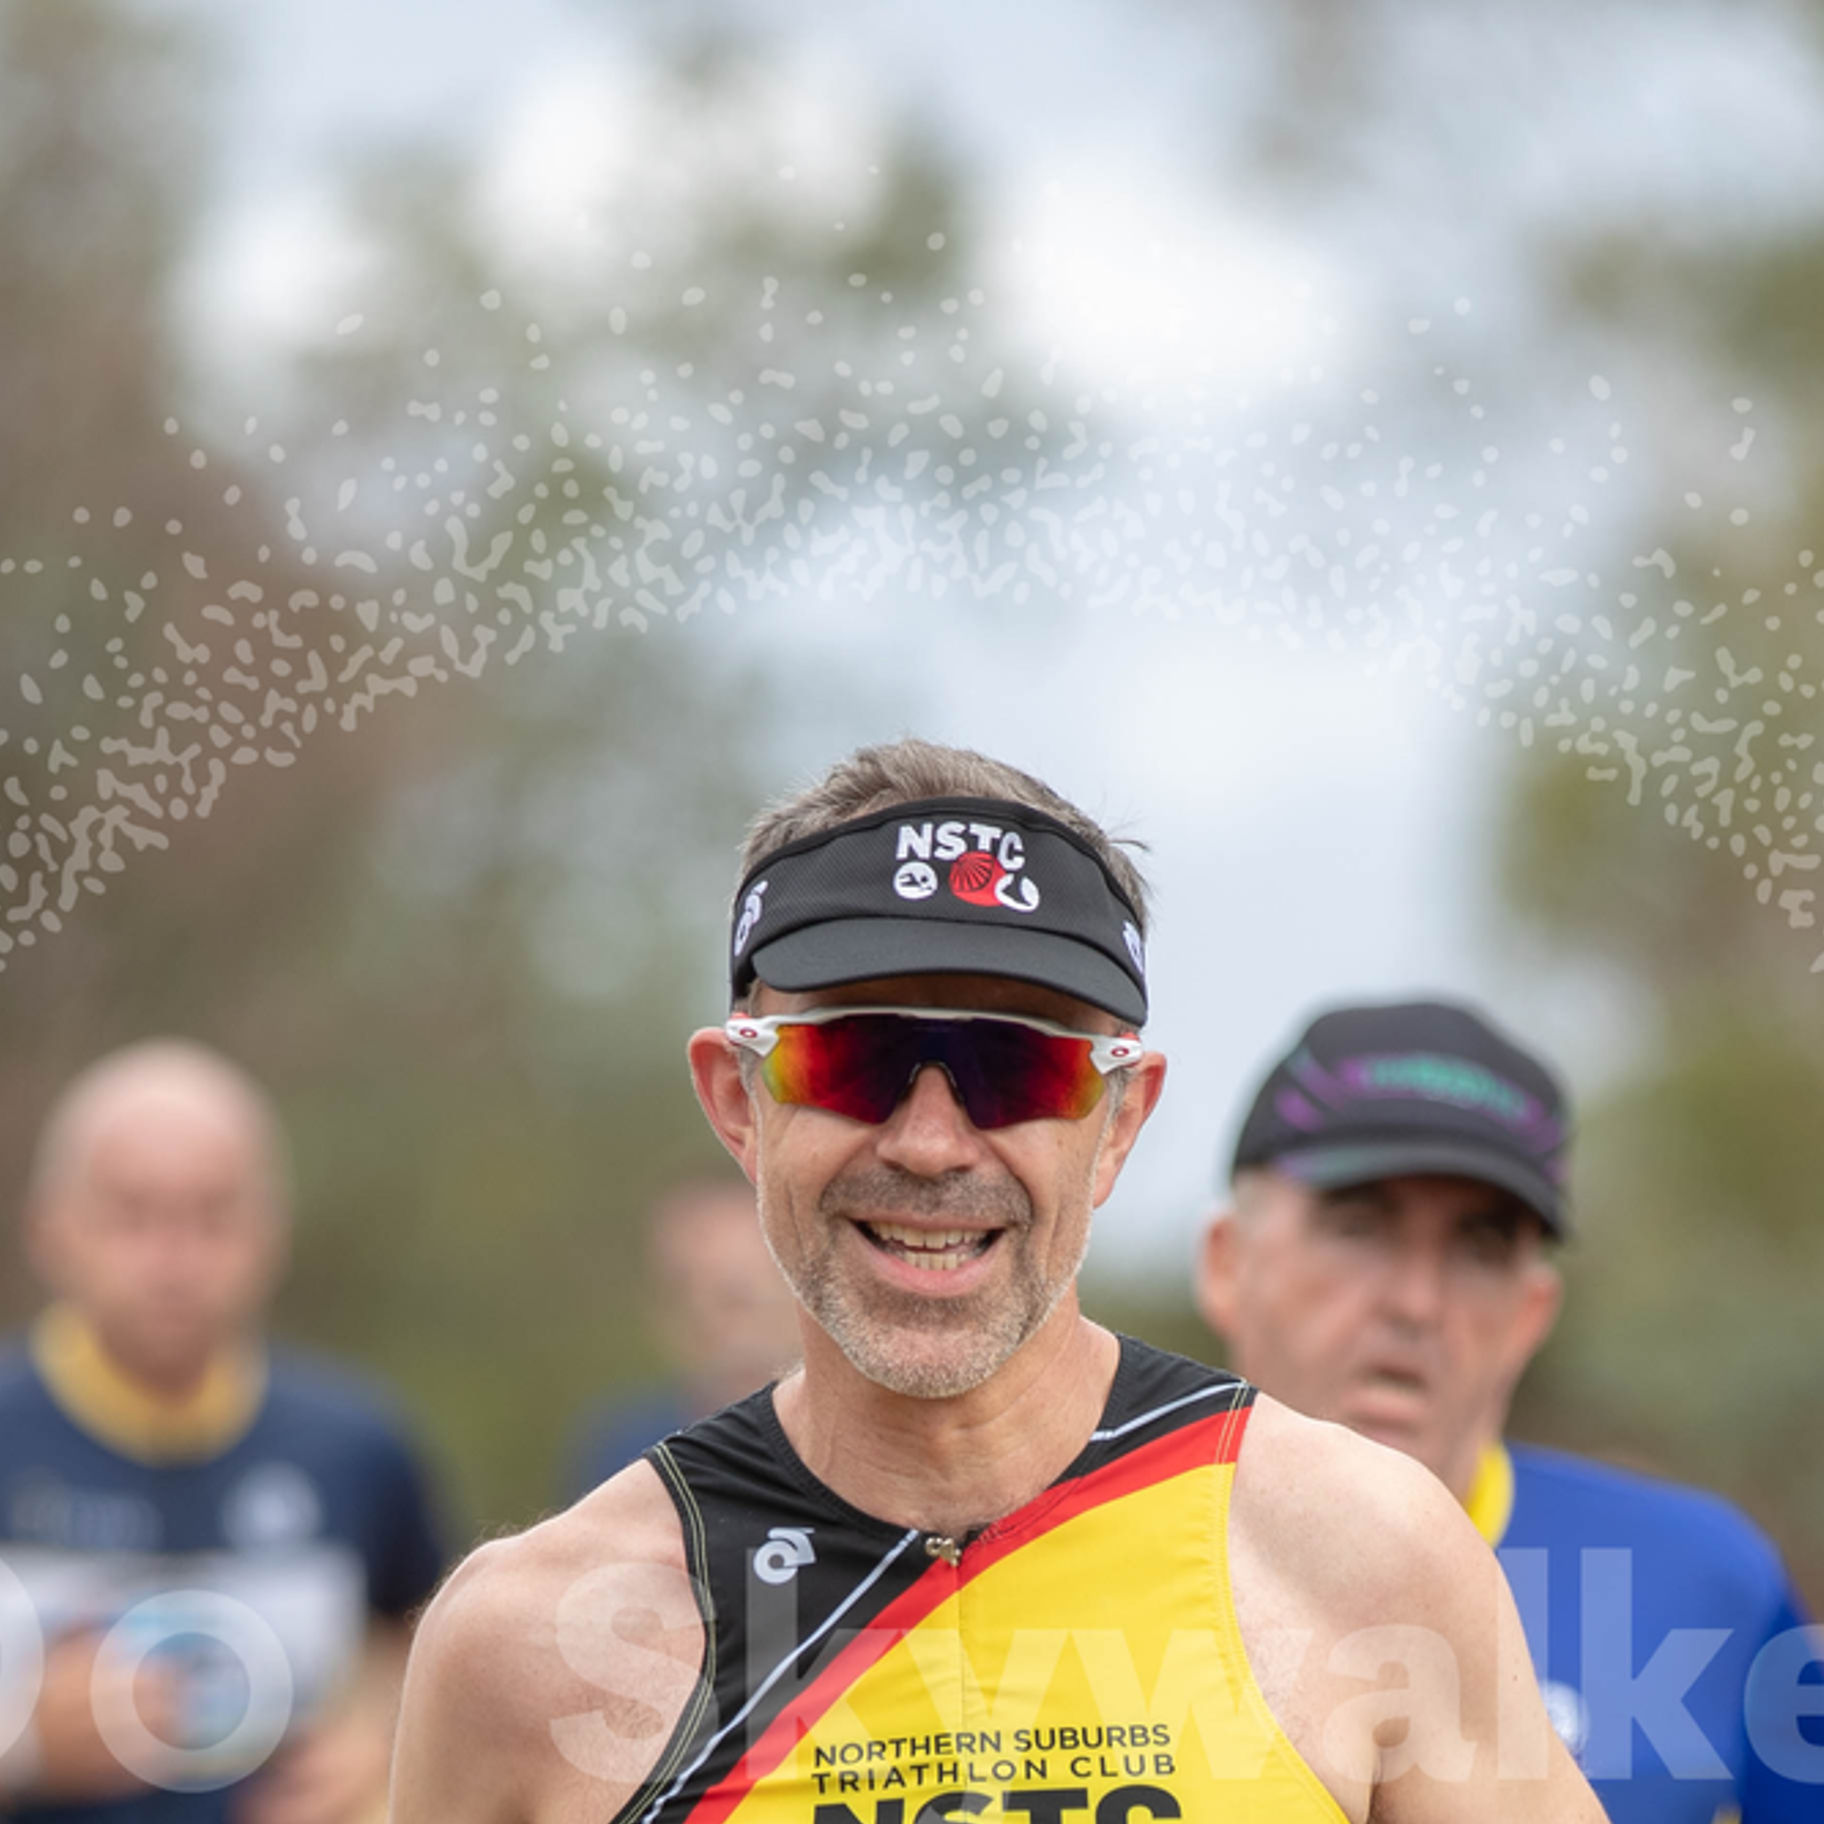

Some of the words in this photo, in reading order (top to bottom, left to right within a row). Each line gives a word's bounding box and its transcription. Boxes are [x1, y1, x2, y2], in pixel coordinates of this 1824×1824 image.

[895, 821, 1026, 872] NSTC
[814, 1730, 1002, 1769] NORTHERN
[1014, 1723, 1171, 1753] SUBURBS
[811, 1758, 1048, 1795] TRIATHLON
[1069, 1753, 1176, 1779] CLUB
